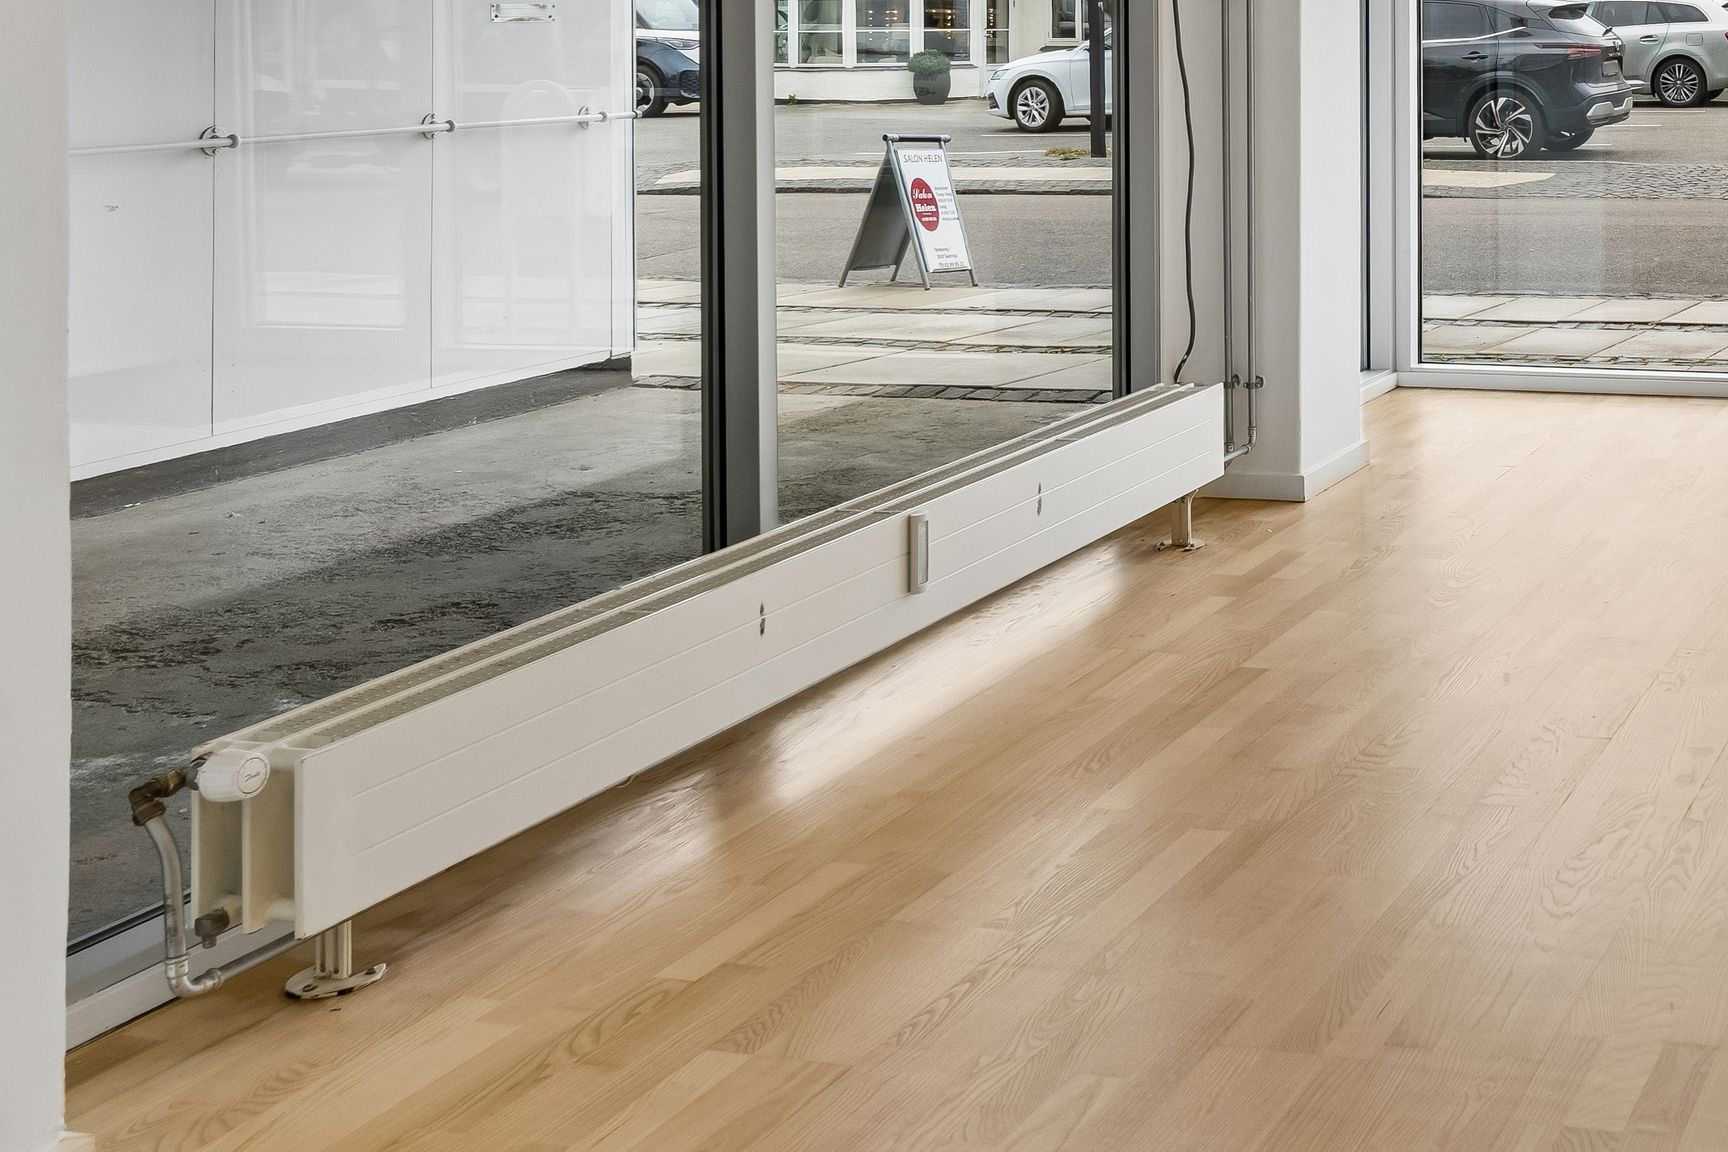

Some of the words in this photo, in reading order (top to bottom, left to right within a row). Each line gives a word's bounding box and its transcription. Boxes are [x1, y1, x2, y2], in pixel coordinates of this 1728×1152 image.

[903, 154, 923, 163] SALON
[923, 154, 943, 163] HELEN
[915, 203, 937, 212] Helen
